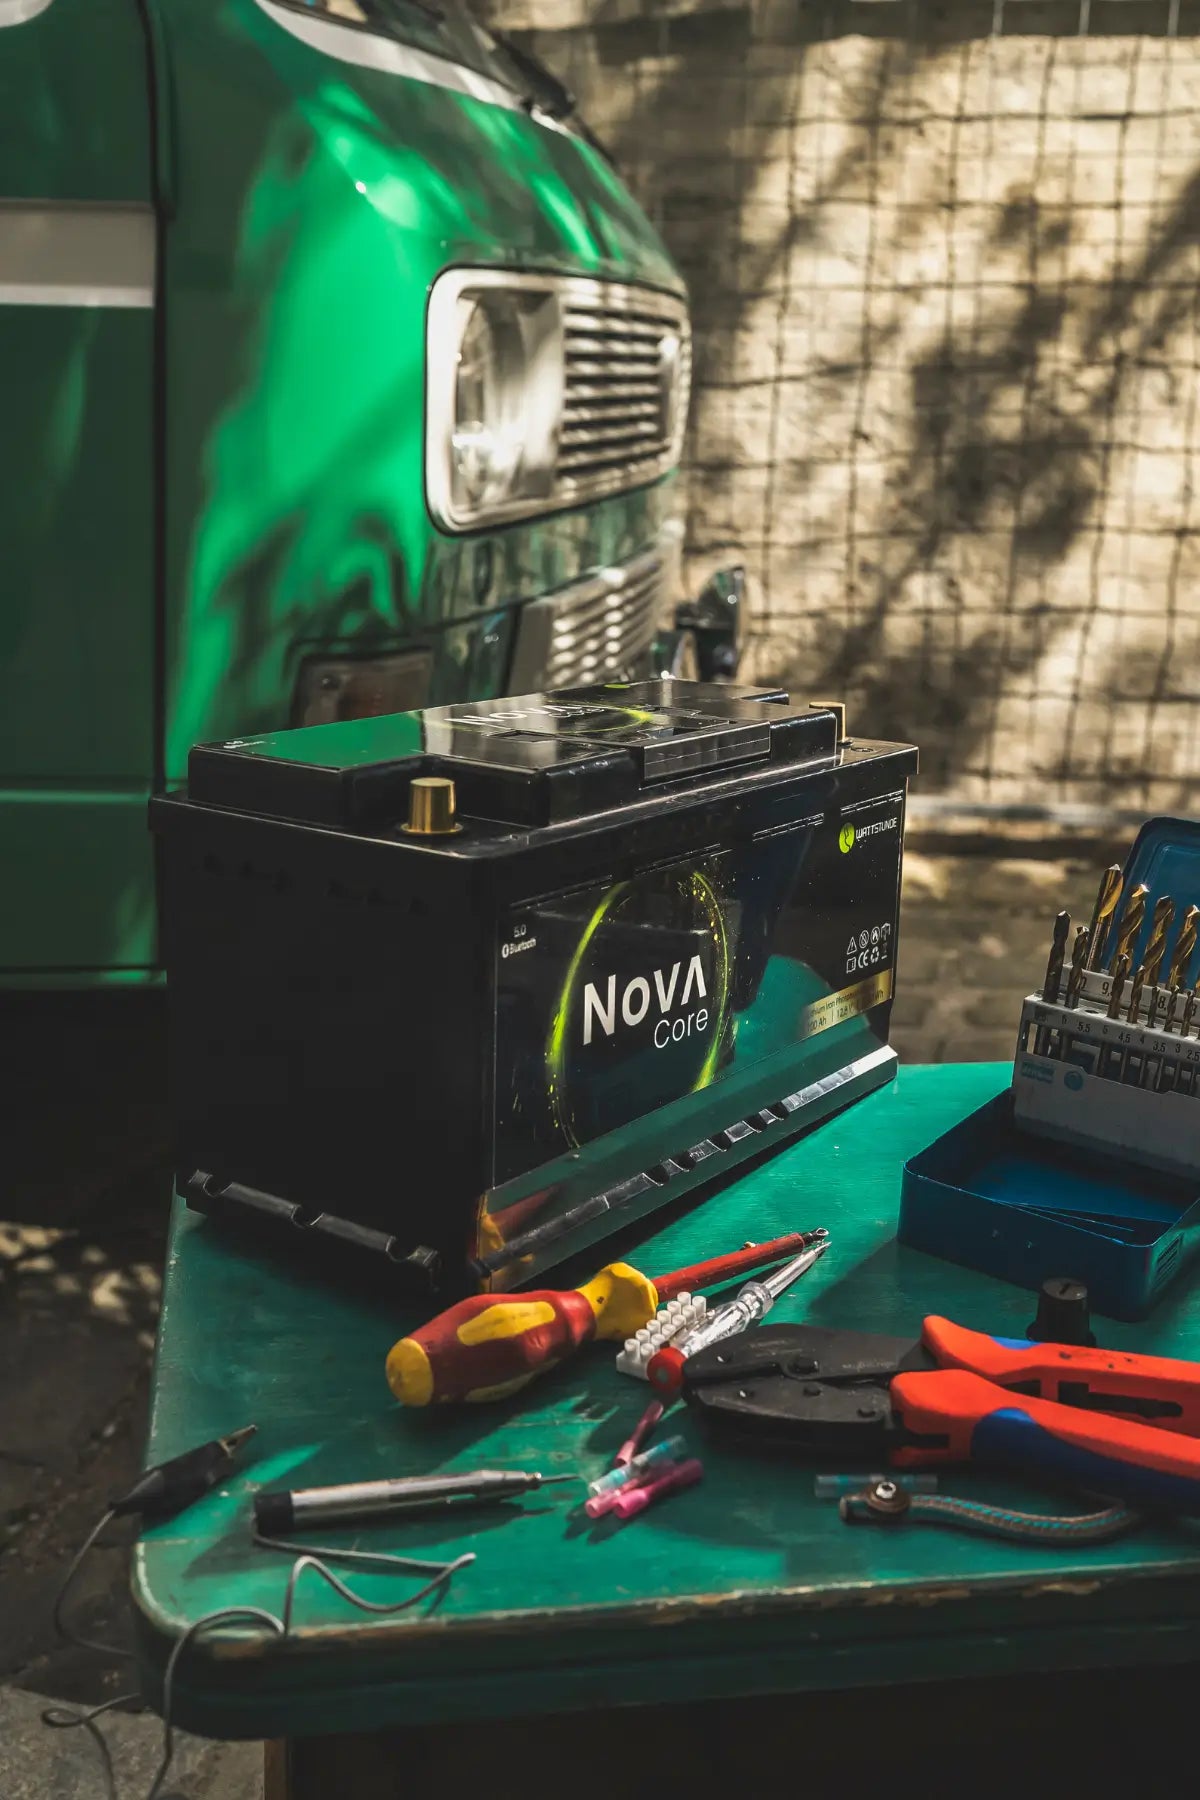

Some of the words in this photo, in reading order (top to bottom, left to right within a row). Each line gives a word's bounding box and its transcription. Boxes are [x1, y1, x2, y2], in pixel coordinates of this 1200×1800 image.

[444, 704, 582, 725] NOVA
[856, 817, 898, 839] WATTSTUNDE
[583, 954, 707, 1047] NOVA
[654, 1008, 709, 1049] Core
[1103, 1025, 1109, 1035] 5
[1175, 1043, 1182, 1053] 3
